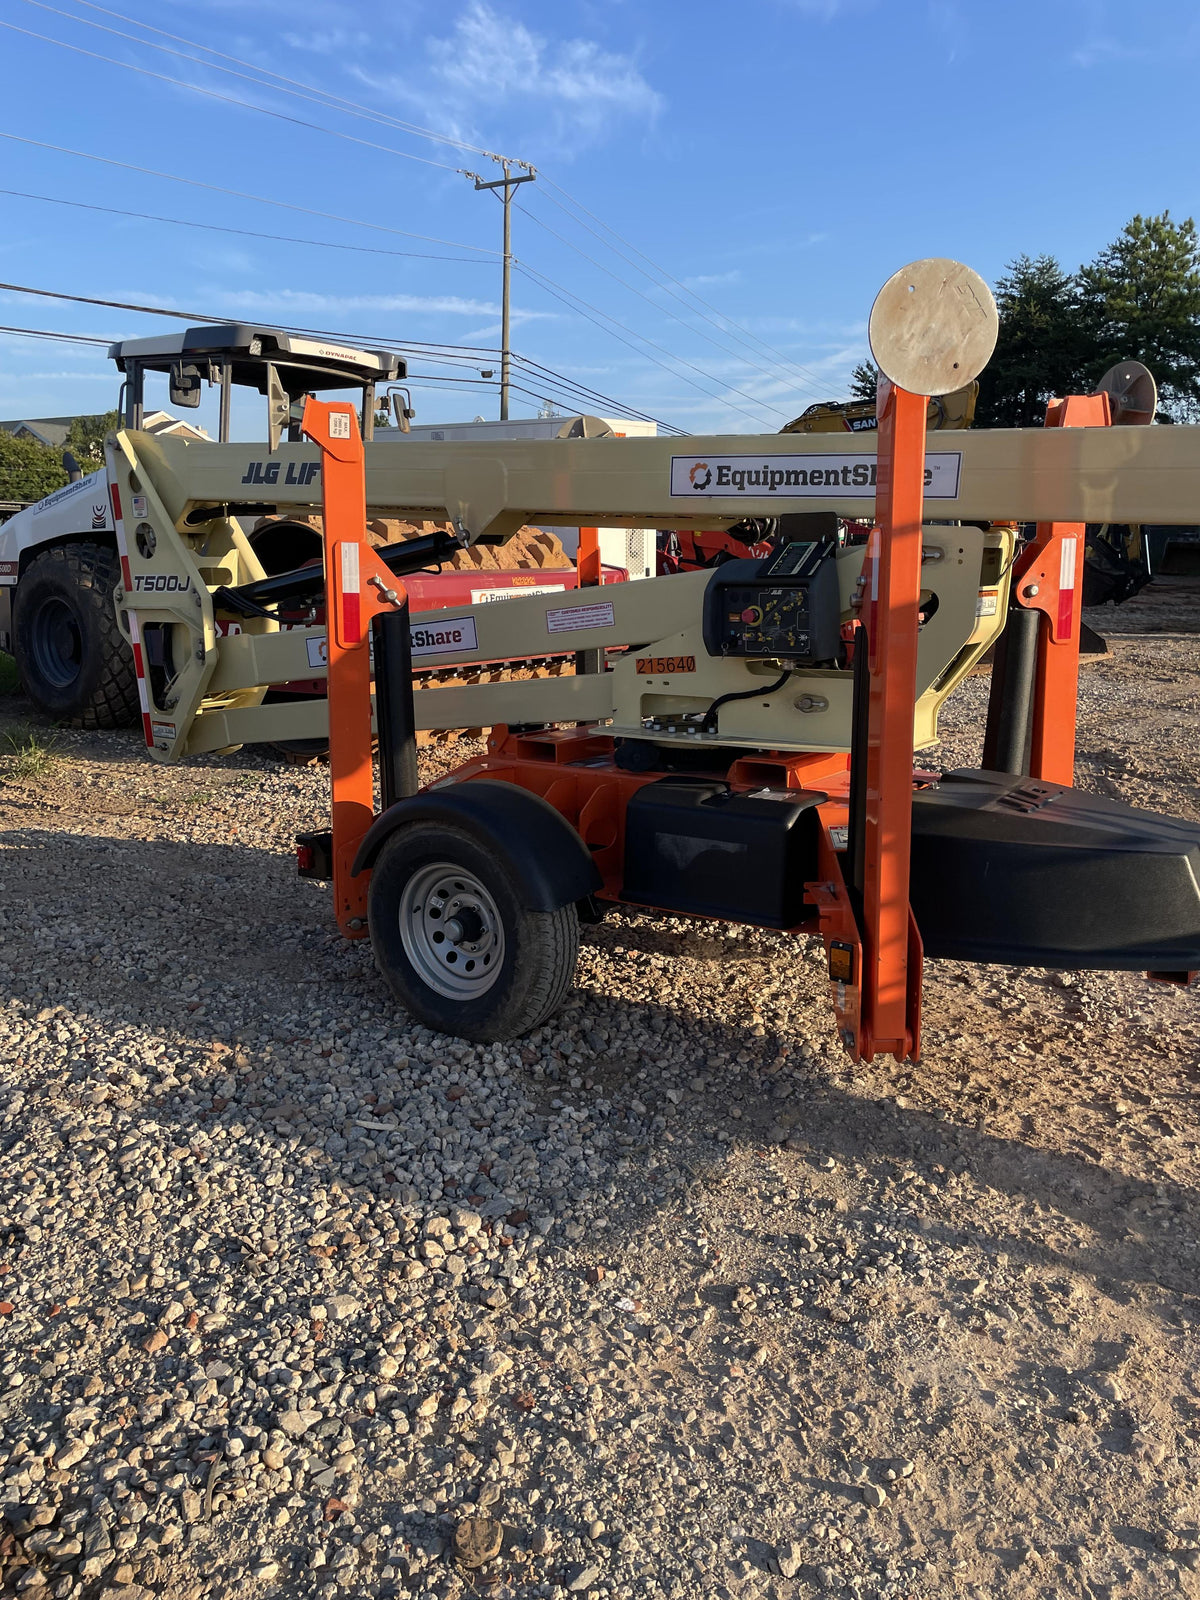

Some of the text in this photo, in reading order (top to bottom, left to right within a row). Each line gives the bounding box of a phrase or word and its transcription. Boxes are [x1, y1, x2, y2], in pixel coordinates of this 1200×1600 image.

[325, 350, 357, 361] DYNAPAC
[853, 418, 876, 430] SAN
[241, 462, 321, 485] JLG LIF
[44, 478, 92, 507] EquipmentShare
[134, 575, 190, 591] T500J
[636, 656, 696, 674] 215640
